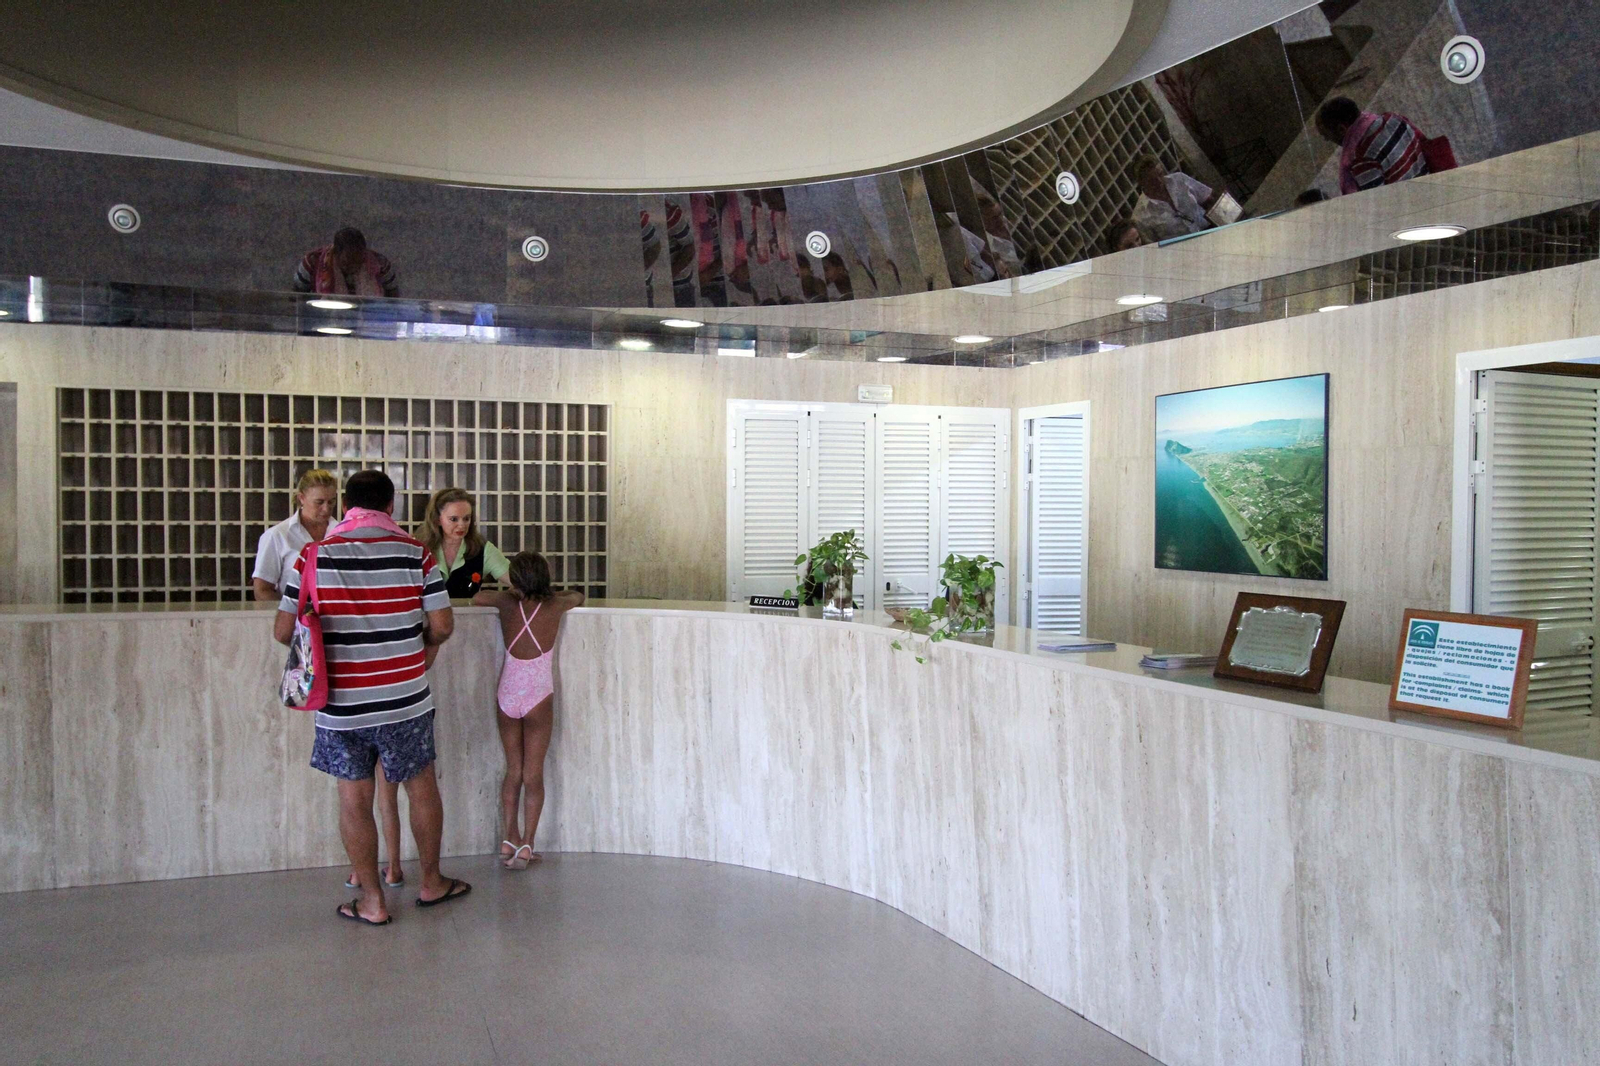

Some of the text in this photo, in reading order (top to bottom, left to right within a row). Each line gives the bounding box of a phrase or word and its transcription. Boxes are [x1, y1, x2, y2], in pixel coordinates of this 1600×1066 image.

[754, 598, 796, 606] RECEPCION
[1456, 640, 1518, 651] establecimiento
[1406, 653, 1442, 662] disposición
[1456, 660, 1498, 669] consumidor
[1443, 652, 1502, 663] reclamaciones
[1418, 674, 1468, 686] establishment
[1416, 693, 1442, 702] request
[1430, 689, 1458, 698] disposal
[1469, 694, 1508, 706] consumers
